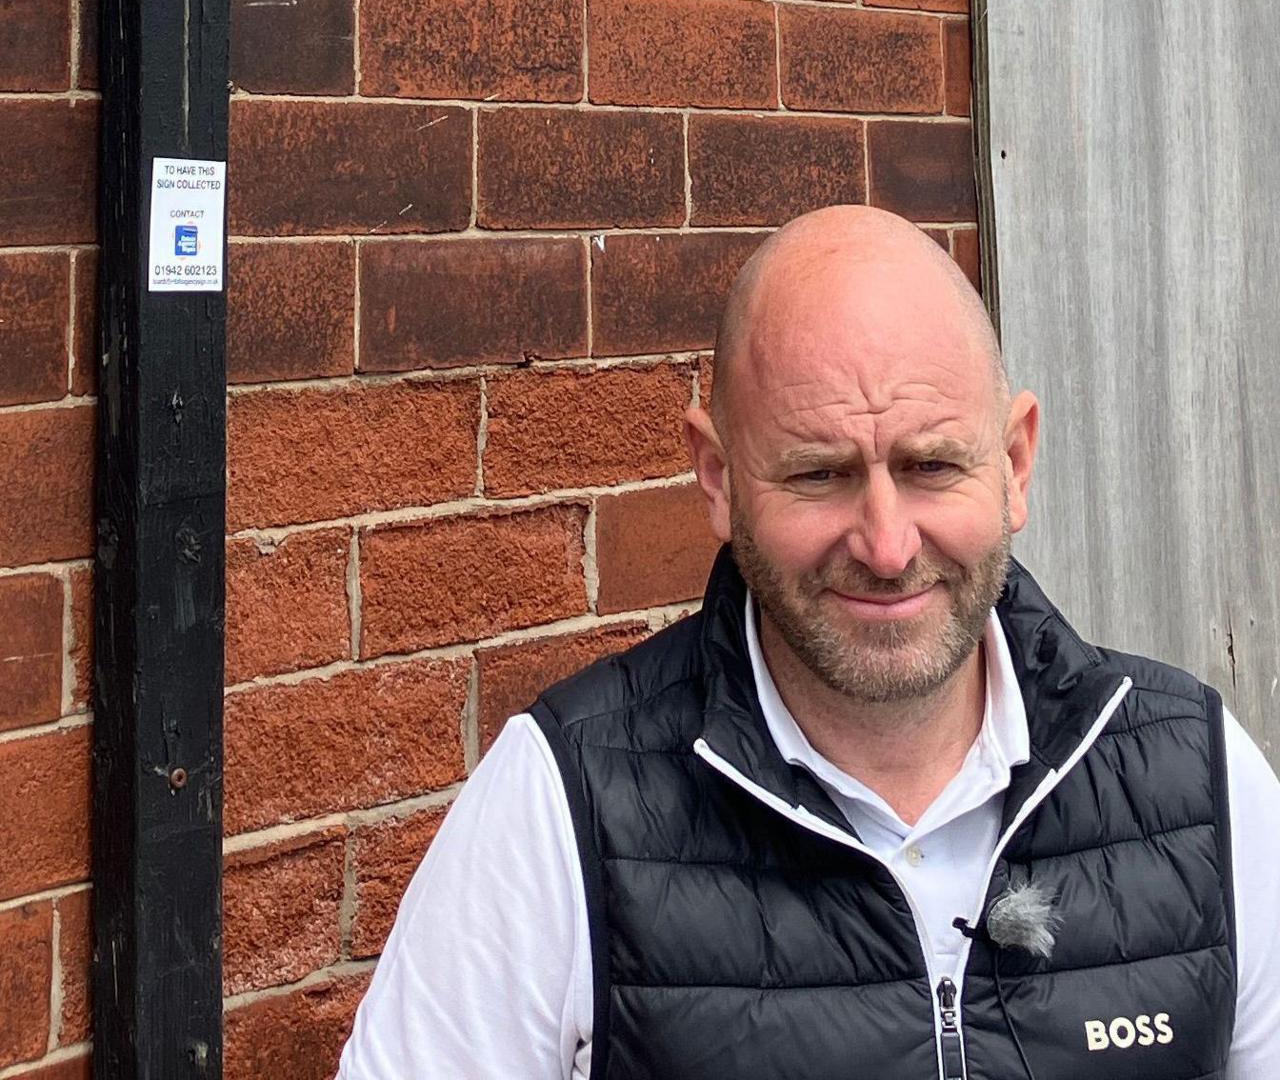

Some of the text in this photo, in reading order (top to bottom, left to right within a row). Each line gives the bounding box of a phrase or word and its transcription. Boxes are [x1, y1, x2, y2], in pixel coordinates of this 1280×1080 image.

[164, 165, 215, 176] TO HAVE THIS
[156, 179, 221, 190] SIGN COLLECTED
[170, 209, 205, 219] CONTACT
[154, 264, 217, 276] 01942 602123
[1084, 1012, 1174, 1051] BOSS
